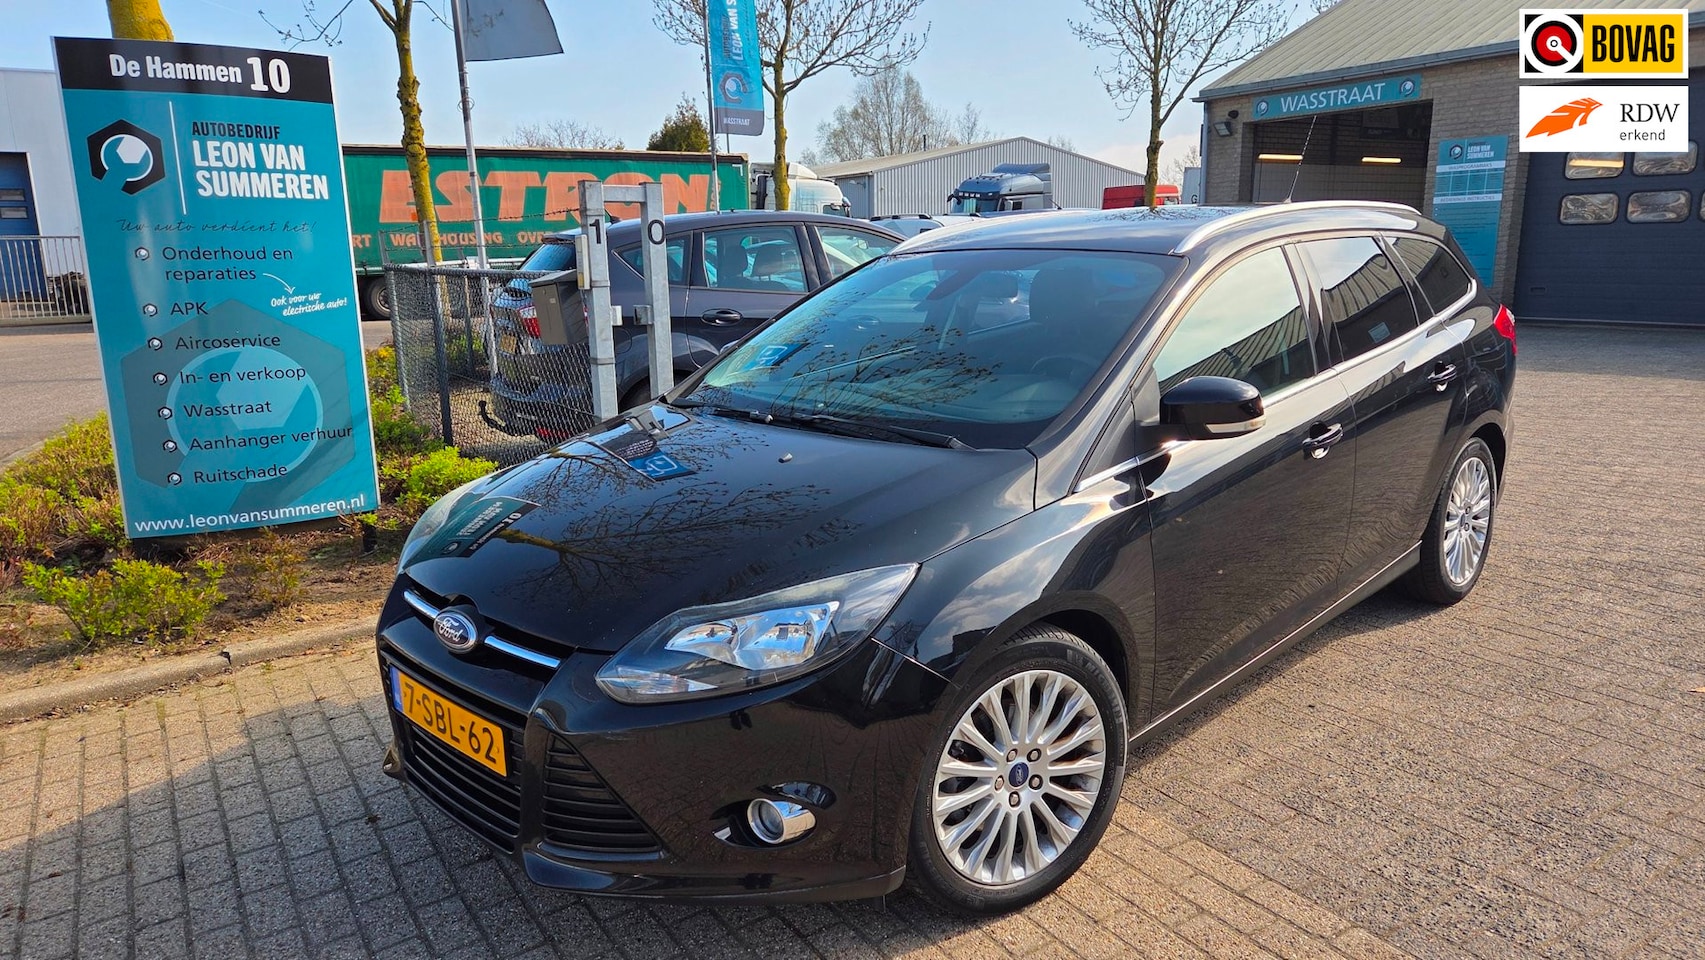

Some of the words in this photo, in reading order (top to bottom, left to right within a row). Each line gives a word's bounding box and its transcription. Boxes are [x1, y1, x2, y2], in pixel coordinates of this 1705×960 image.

[727, 8, 738, 30] VAN
[731, 32, 743, 60] LEON
[109, 54, 141, 78] De
[147, 56, 243, 83] Hammen
[246, 57, 291, 94] 10
[1280, 83, 1386, 113] WASSTRAAT
[191, 121, 281, 140] AUTOBEDRIJF
[191, 140, 257, 170] LEON
[259, 143, 306, 172] VAN
[195, 171, 330, 200] SUMMEREN
[116, 219, 147, 232] Uw
[154, 219, 195, 232] auto
[201, 220, 280, 232] verdient
[282, 219, 317, 233] het!
[589, 218, 602, 245] 1
[162, 246, 267, 261] Onderhoud
[272, 249, 293, 260] en
[165, 267, 257, 283] reparaties
[170, 301, 209, 316] APK
[271, 295, 287, 307] Ook
[288, 295, 307, 304] voor
[308, 292, 322, 300] uw
[282, 301, 325, 316] electrische
[326, 297, 347, 308] auto!
[175, 334, 281, 351] Aircoservice
[179, 371, 203, 385] In-
[209, 371, 231, 383] en
[236, 366, 306, 385] verkoop
[183, 401, 272, 418] Wasstraat
[189, 432, 286, 452] Aanhanger
[291, 426, 353, 443] verhuur
[193, 464, 288, 483] Ruitschade
[135, 494, 365, 532] www.leonvansummeren.nl
[438, 617, 464, 641] Ford
[404, 682, 497, 764] 7-SBL-62
